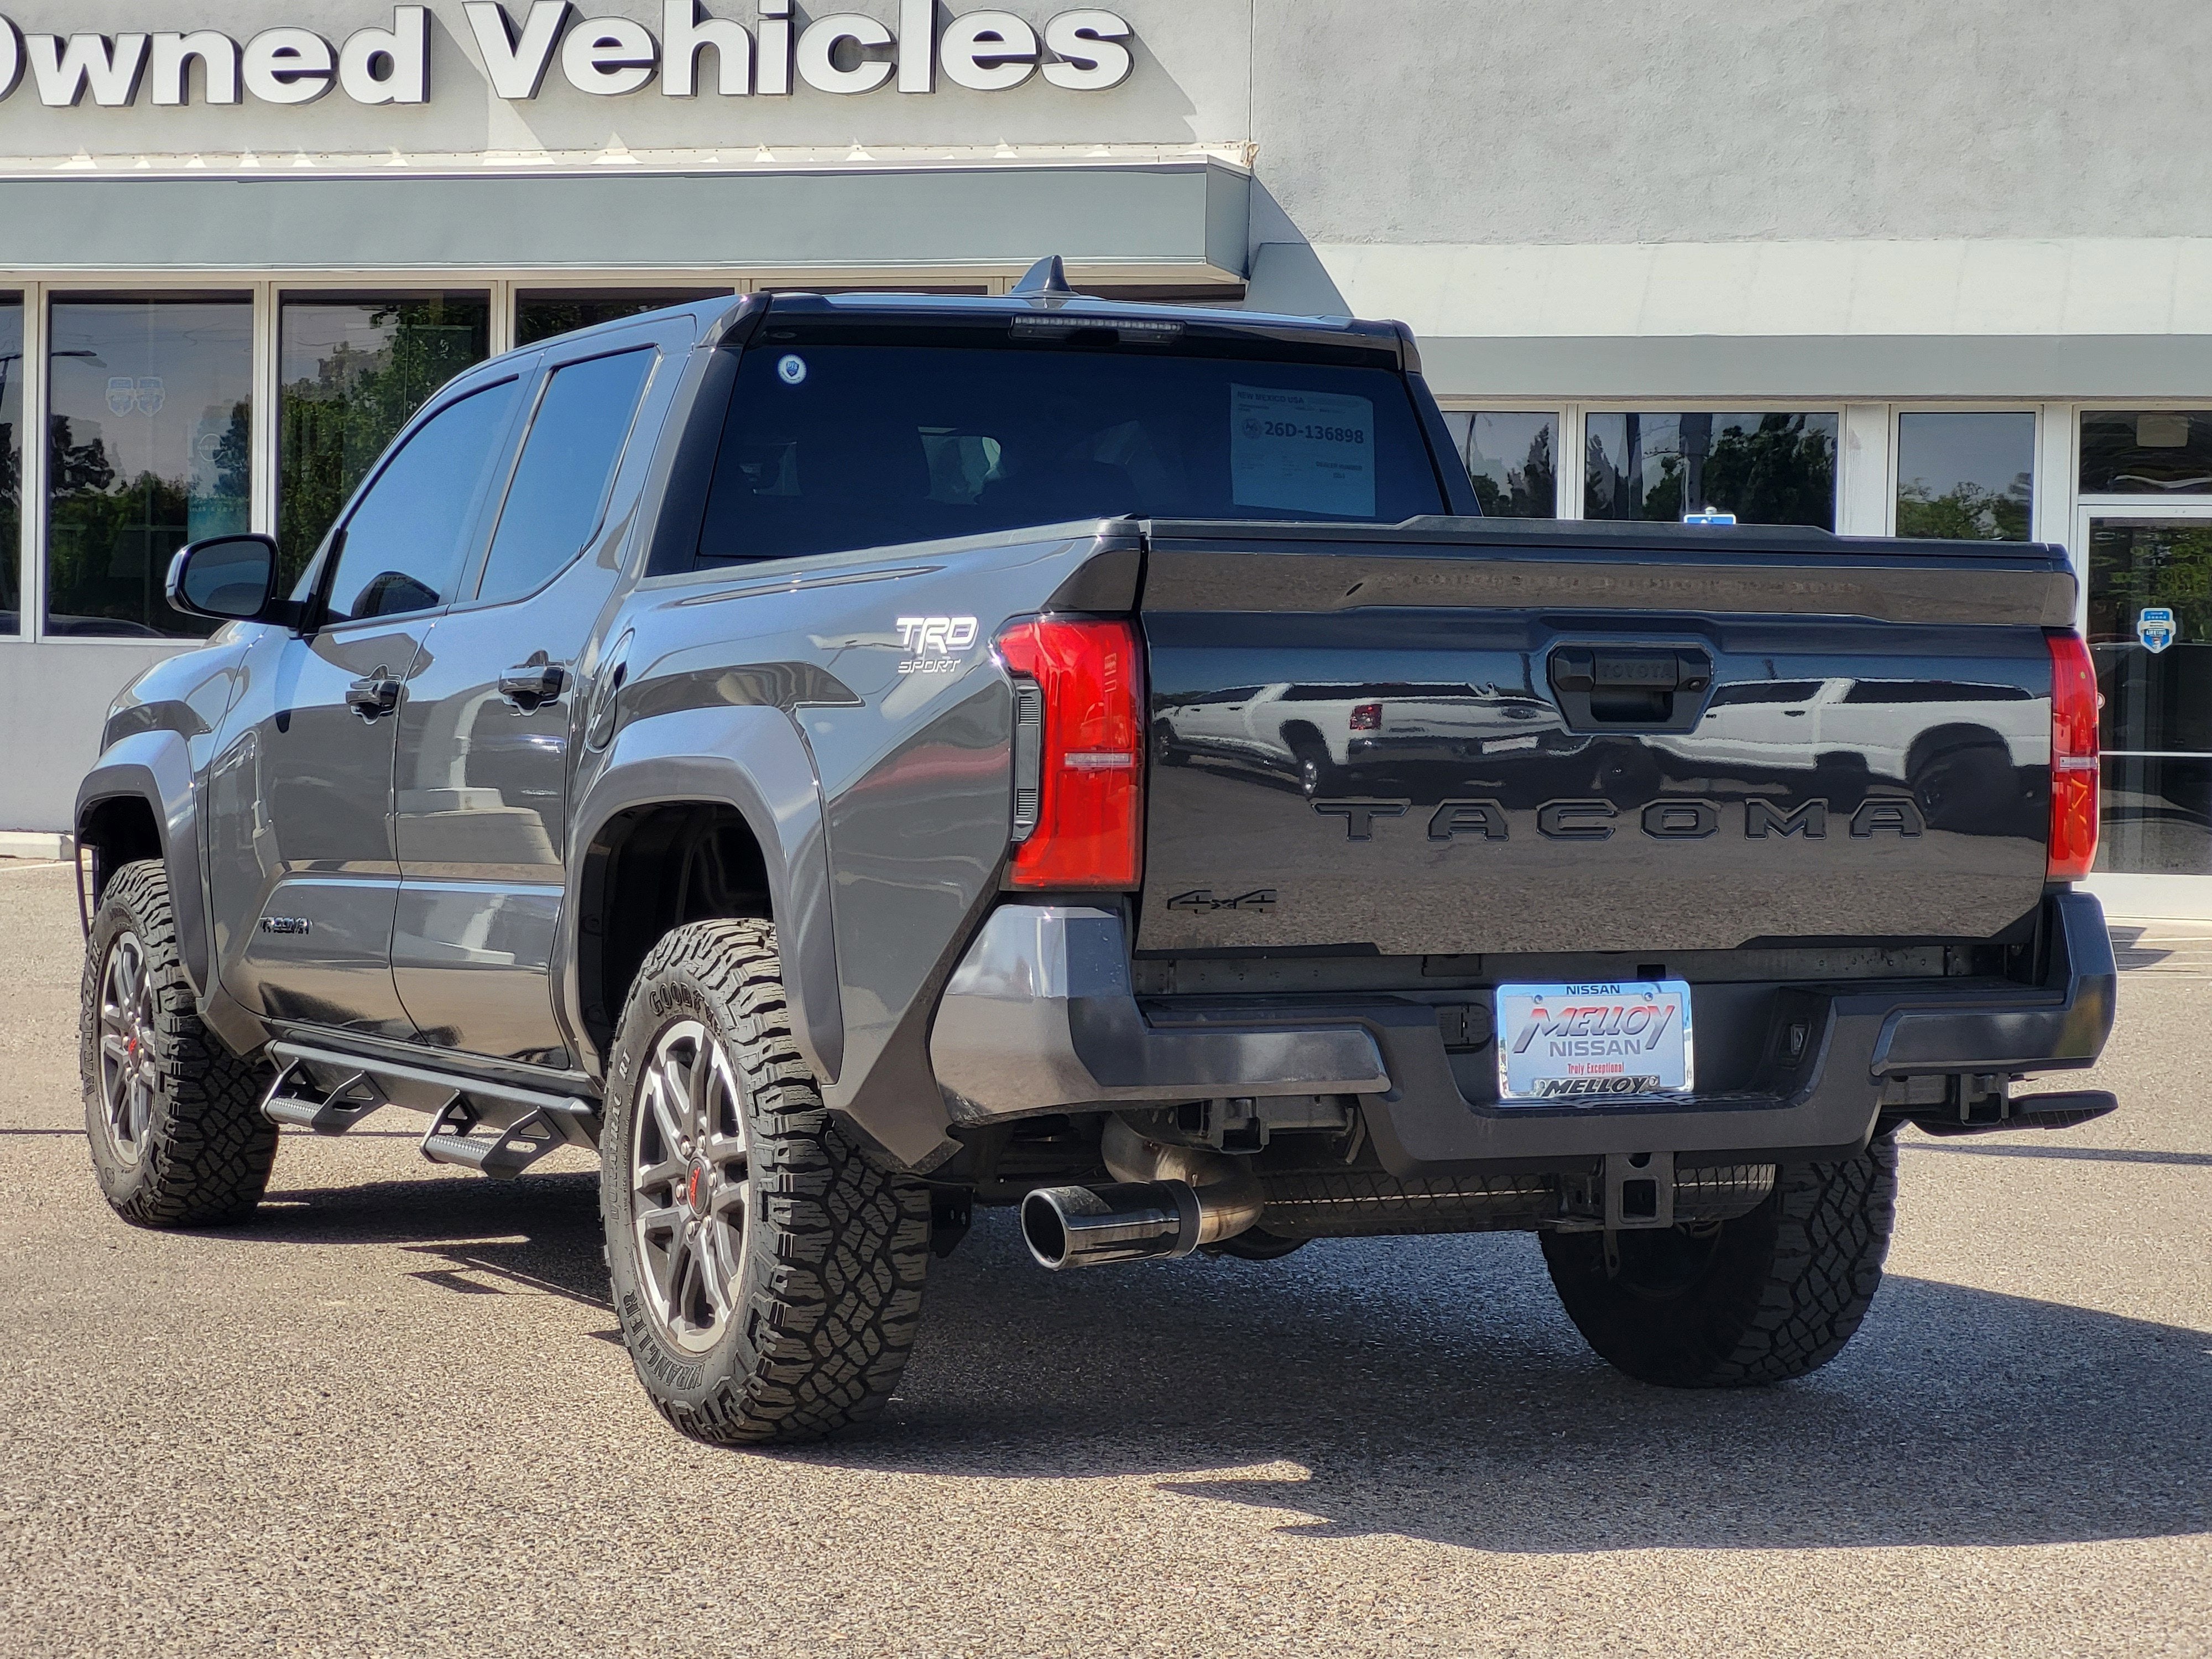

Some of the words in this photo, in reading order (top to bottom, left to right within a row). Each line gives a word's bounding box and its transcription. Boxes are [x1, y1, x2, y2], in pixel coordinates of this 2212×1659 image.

[0, 6, 432, 107] wned
[462, 0, 1134, 98] Vehicles
[1255, 393, 1285, 402] MEXICO
[1265, 422, 1364, 444] 26D-136898
[896, 617, 979, 658] TRD
[898, 659, 961, 673] SPORT
[1311, 798, 1926, 842] TACOMA
[1566, 985, 1620, 995] NISSAN
[1512, 1005, 1675, 1053] MELLOY
[1550, 1040, 1641, 1057] NISSAN
[618, 1048, 631, 1080] RT
[1568, 1063, 1584, 1074] Truly
[1587, 1062, 1625, 1073] Exceptional
[1542, 1078, 1648, 1097] MELLOY
[623, 1289, 705, 1390] WRANGLER
